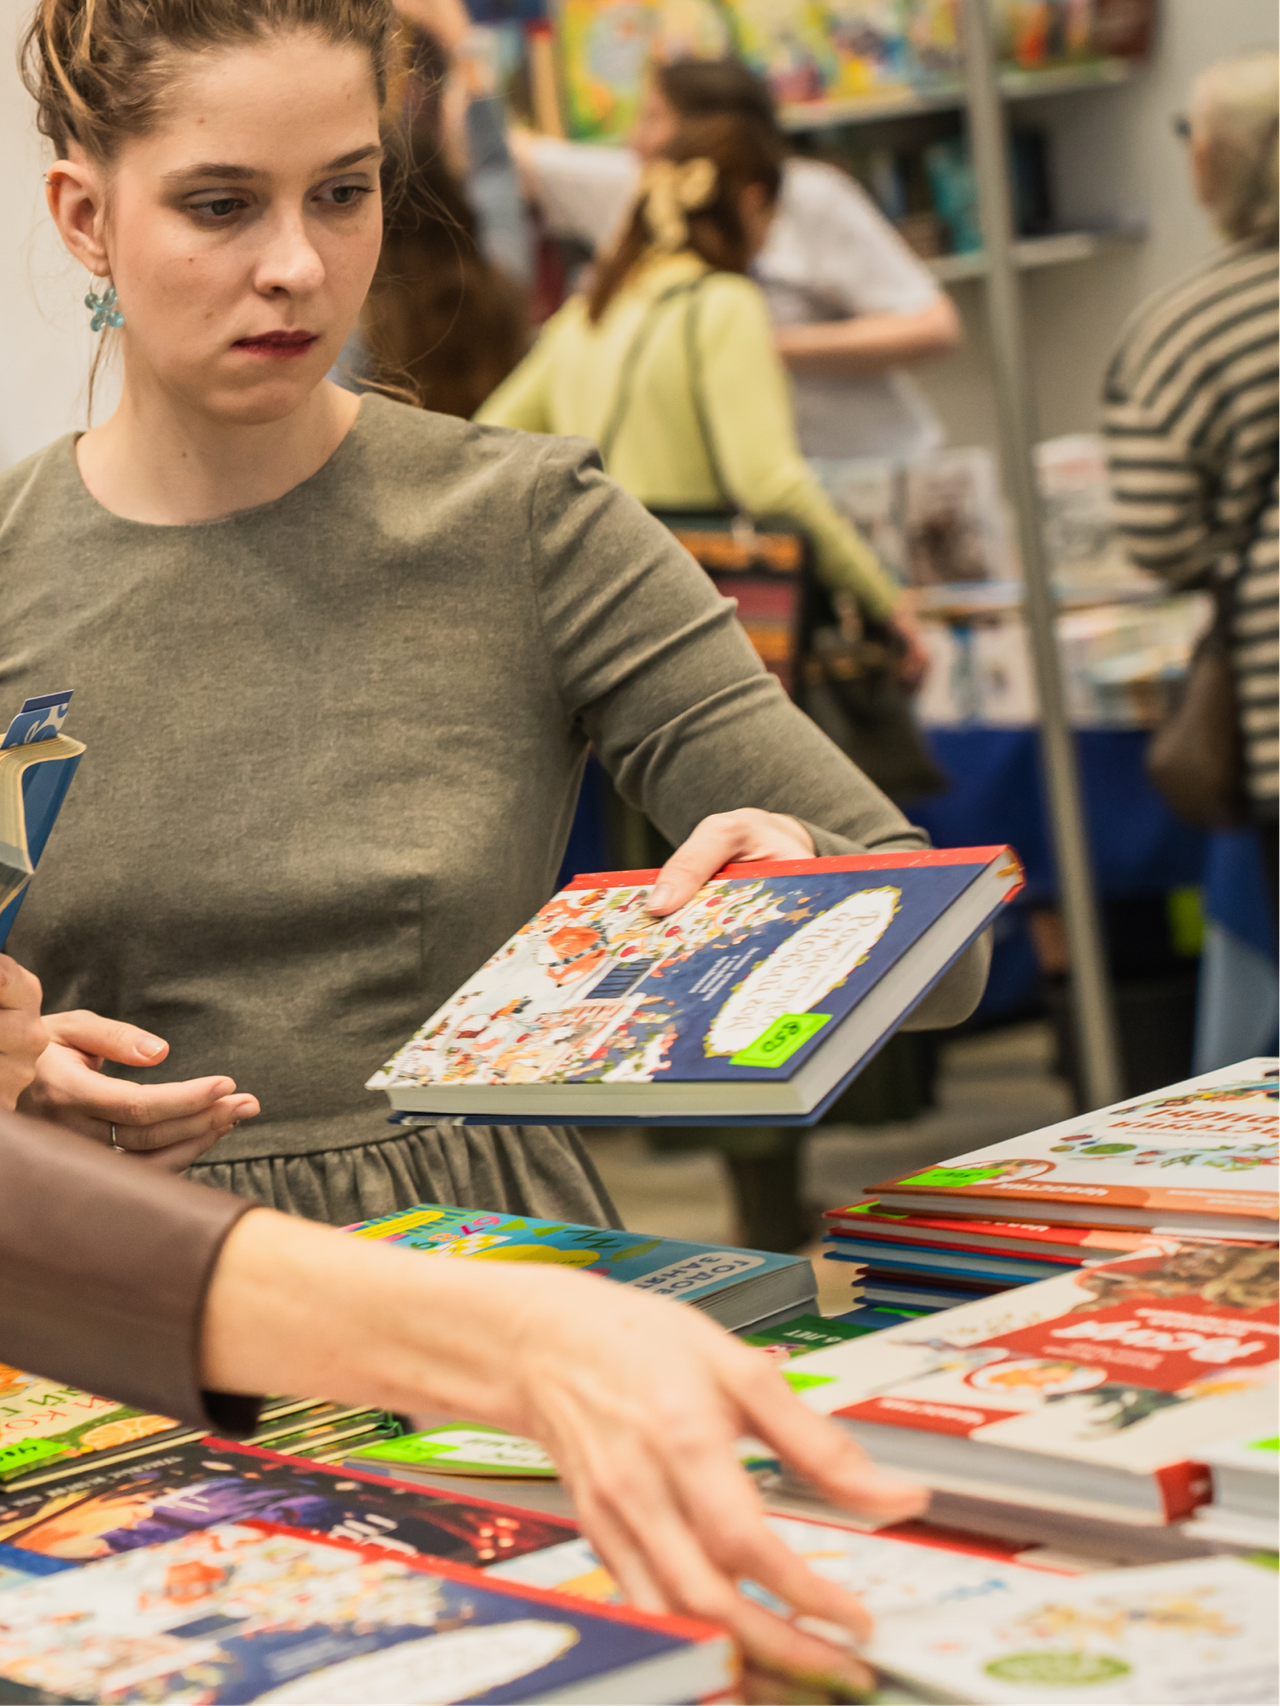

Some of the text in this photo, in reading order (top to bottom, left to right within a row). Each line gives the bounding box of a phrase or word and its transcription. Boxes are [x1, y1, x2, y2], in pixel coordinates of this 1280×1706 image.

[748, 927, 831, 997] Новый
[759, 910, 882, 1027] Рождество
[1106, 1120, 1280, 1139] астения
[633, 1256, 721, 1289] ЗАНЯТ
[653, 1260, 751, 1295] ГОДОВ
